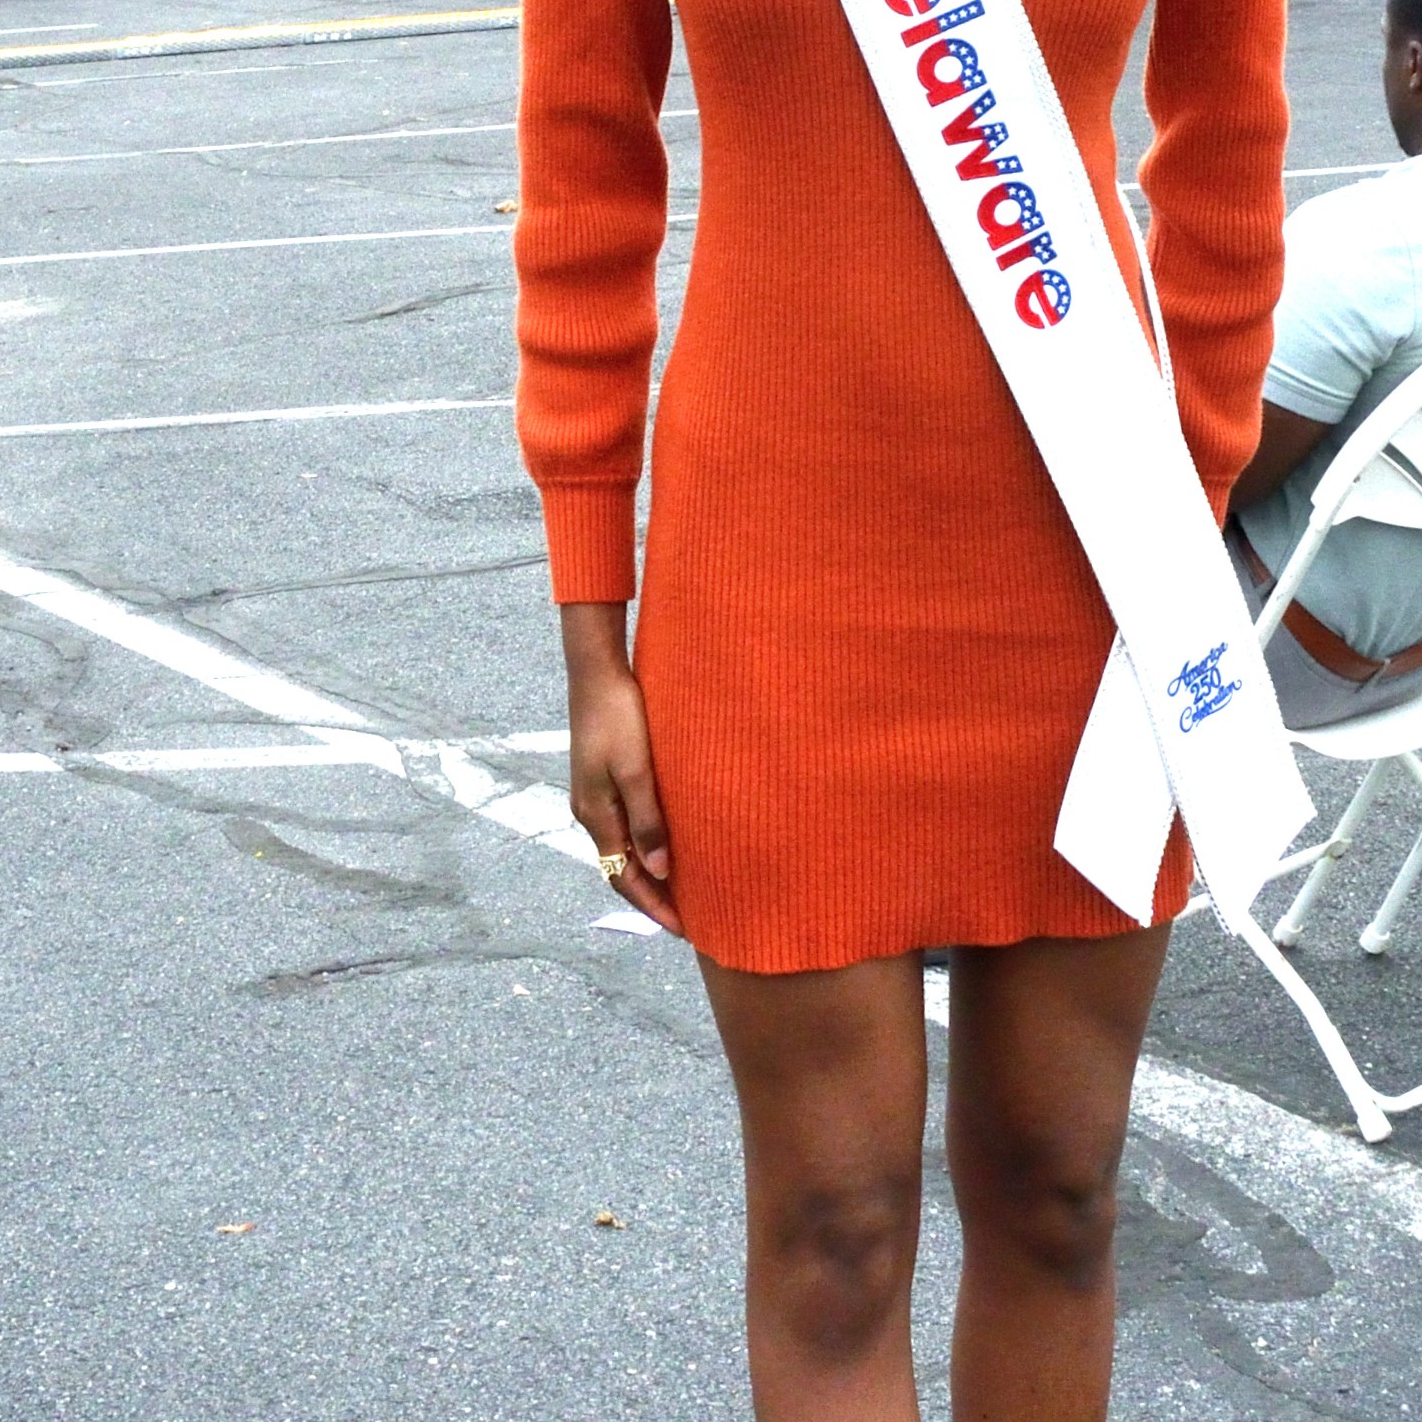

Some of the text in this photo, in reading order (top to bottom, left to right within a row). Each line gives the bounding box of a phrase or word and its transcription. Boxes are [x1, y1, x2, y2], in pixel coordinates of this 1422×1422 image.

[1167, 641, 1228, 697] America
[1190, 665, 1222, 706] 250
[1179, 679, 1242, 733] Celebration
